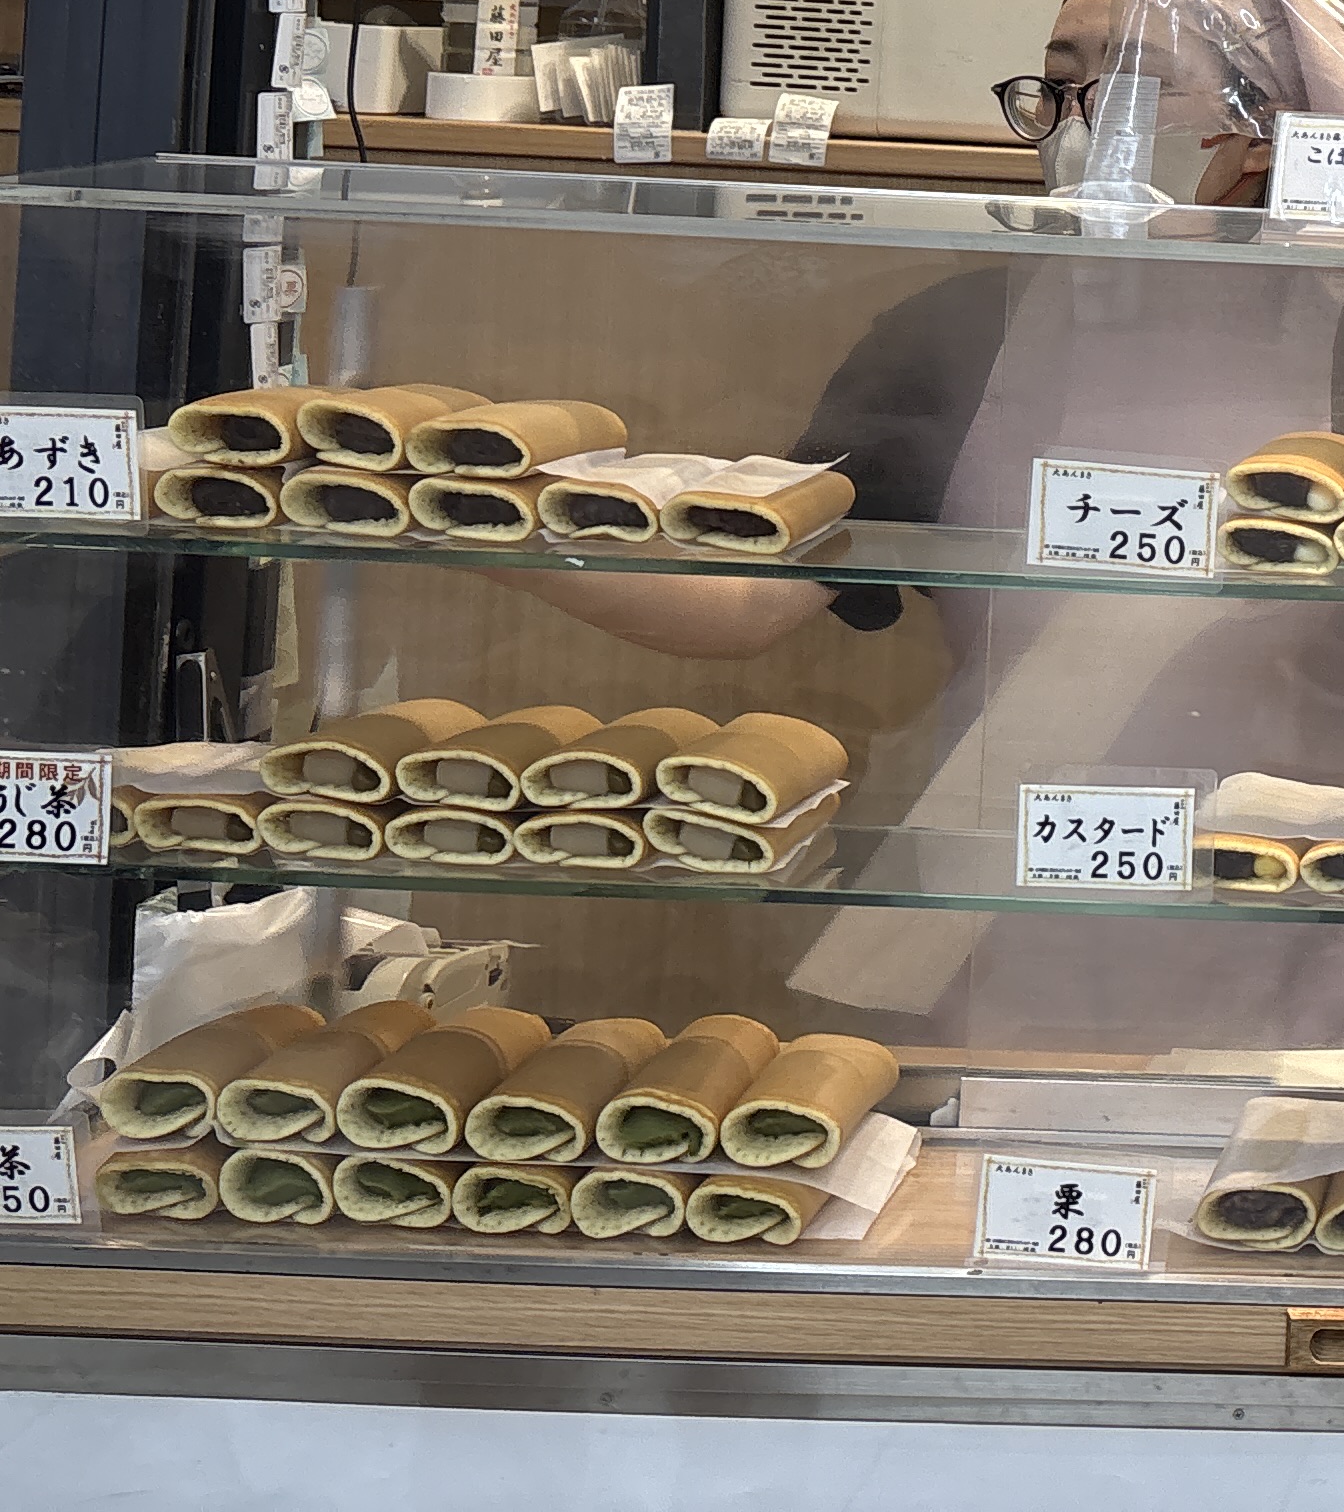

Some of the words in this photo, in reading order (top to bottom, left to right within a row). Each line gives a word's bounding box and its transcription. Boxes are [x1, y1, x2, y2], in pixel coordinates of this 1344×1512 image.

[0, 435, 101, 474] あずき
[33, 476, 109, 508] 210
[1066, 493, 1189, 531] チーズ
[1108, 530, 1186, 565] 250
[0, 818, 77, 851] 280
[1032, 814, 1171, 848] カスタード
[1090, 850, 1164, 881] 250
[1051, 1183, 1085, 1220] 栗
[1047, 1224, 1122, 1257] 280
